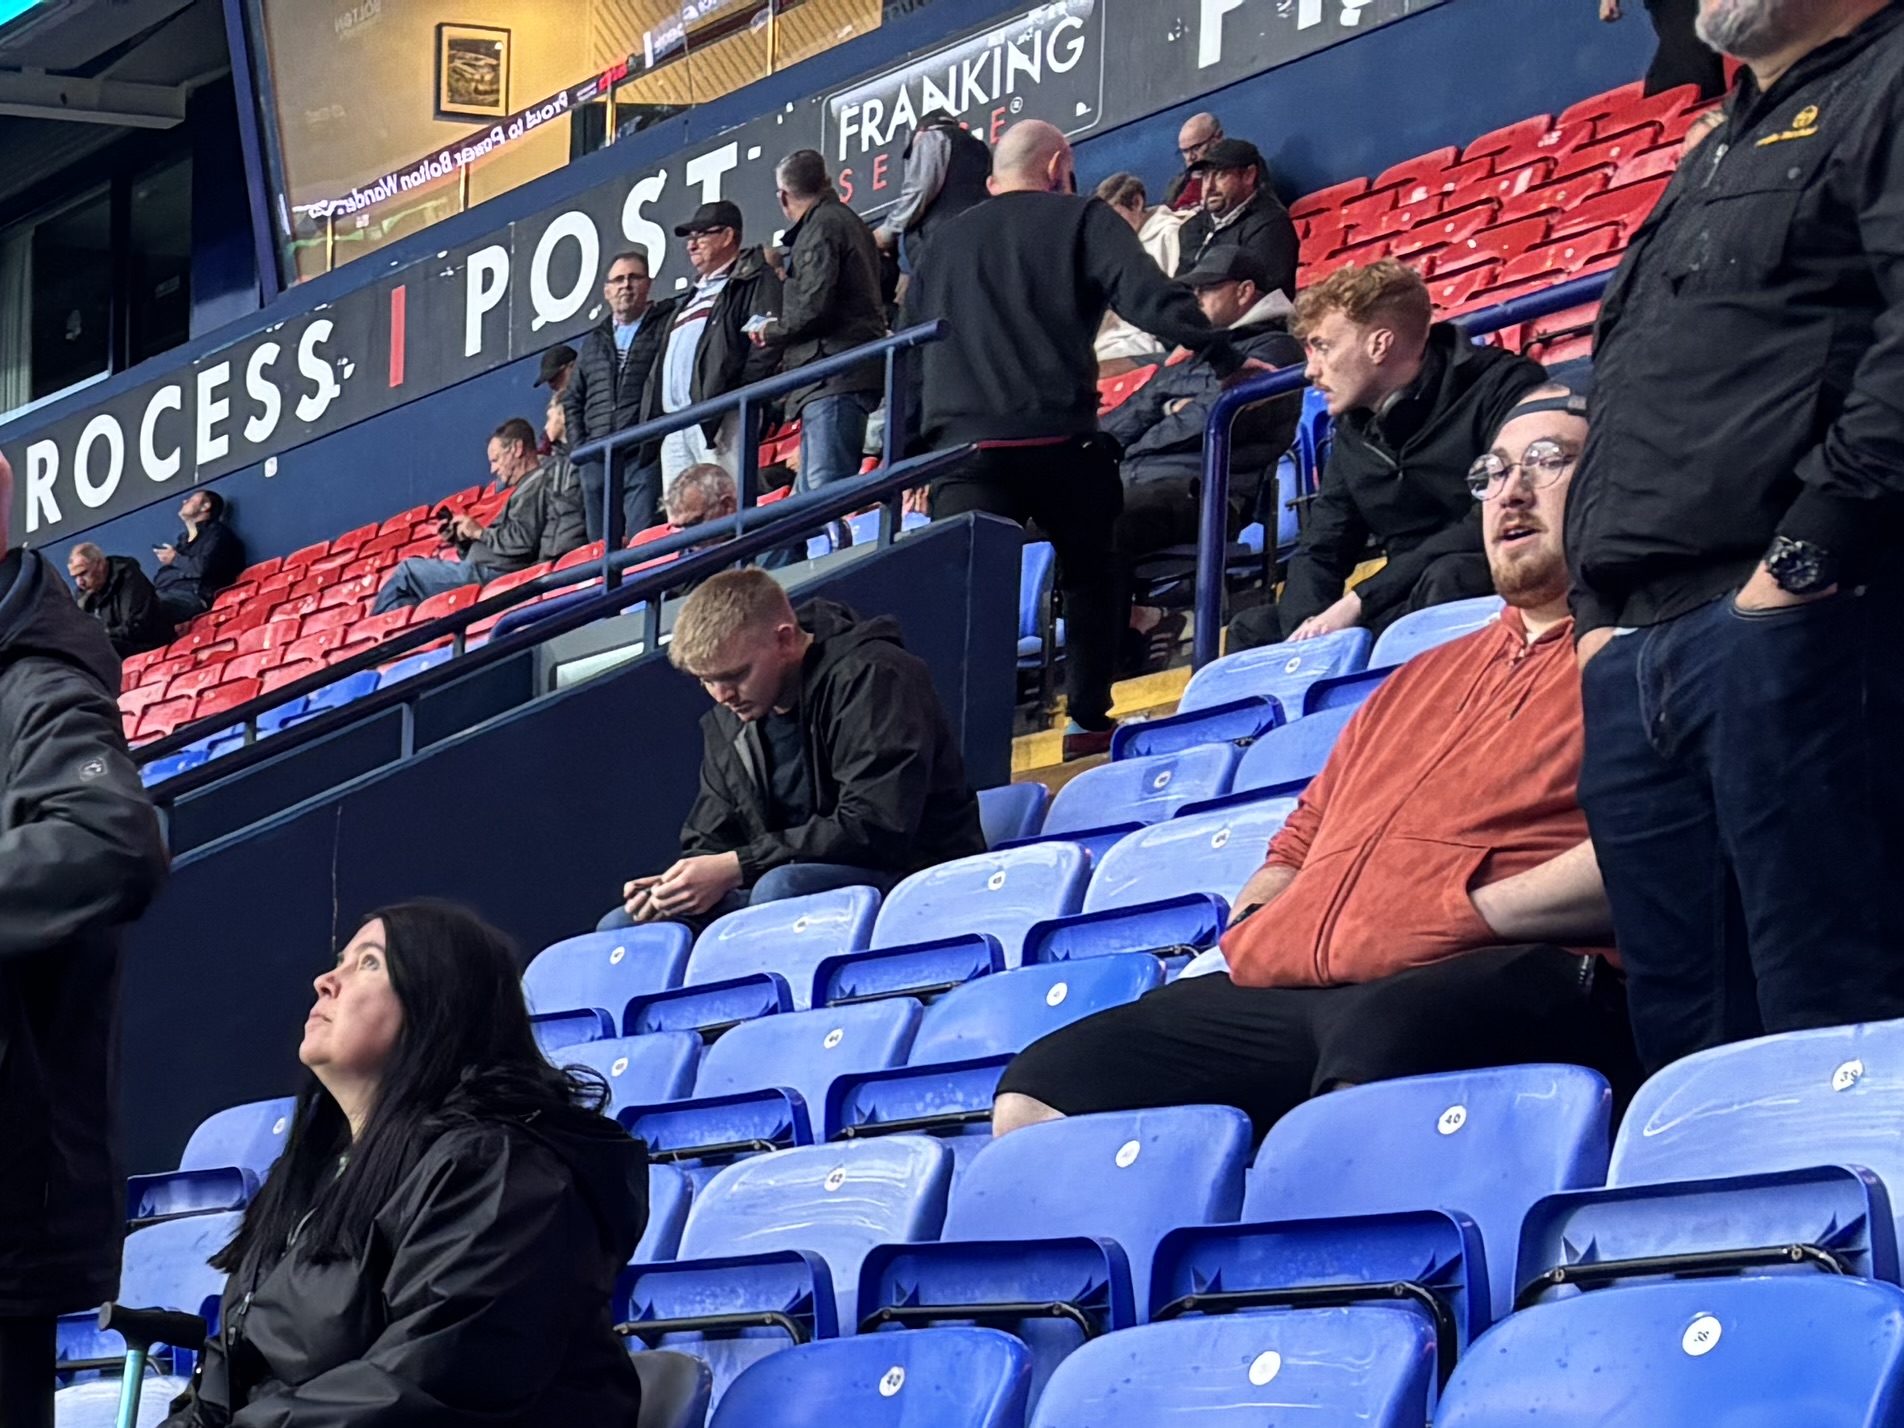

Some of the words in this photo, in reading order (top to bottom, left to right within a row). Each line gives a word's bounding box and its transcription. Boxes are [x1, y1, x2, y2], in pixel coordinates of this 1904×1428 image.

[838, 14, 1087, 161] FRANKING
[465, 141, 738, 357] POST
[25, 318, 342, 534] ROCESS
